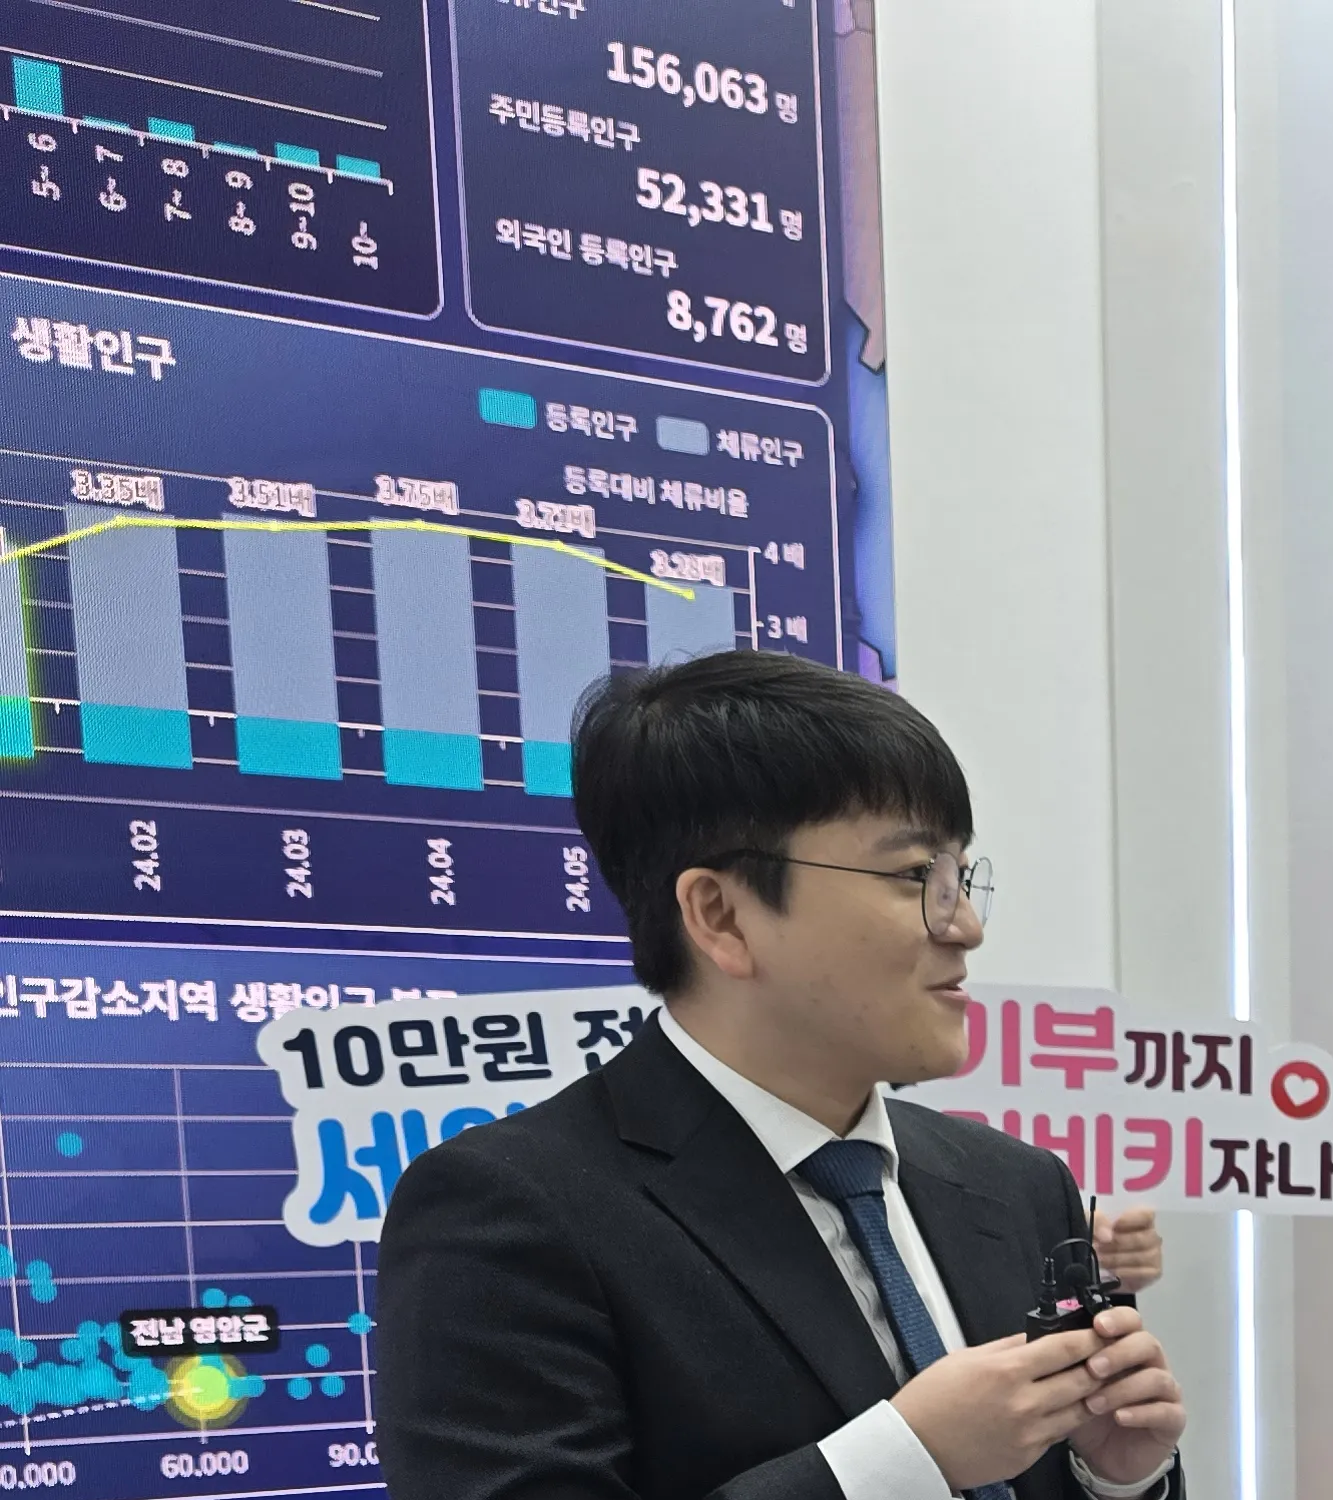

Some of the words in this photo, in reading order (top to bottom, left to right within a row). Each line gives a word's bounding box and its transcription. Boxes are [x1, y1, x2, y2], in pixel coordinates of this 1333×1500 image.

[607, 41, 769, 114] 156,063
[774, 92, 798, 124] 명
[489, 93, 641, 151] 주민등록인구
[636, 167, 774, 233] 52,331
[779, 209, 803, 241] 명
[495, 218, 572, 260] 외국인
[579, 233, 679, 278] 등록인구
[11, 316, 176, 381] 생활인구
[667, 290, 779, 347] 8,762
[784, 322, 808, 354] 명
[545, 401, 638, 442] 등록인구
[716, 429, 804, 467] 체류인구
[564, 465, 656, 504] 등록대비
[660, 479, 749, 519] 체류비율
[767, 615, 784, 639] 3
[129, 819, 161, 892] 24.02
[281, 828, 313, 899] 24.03
[426, 837, 456, 906] 24.04
[563, 845, 592, 913] 24.05
[283, 1011, 552, 1089] 10만원
[949, 999, 1253, 1095] 기부까지
[130, 1317, 186, 1347] 전남
[161, 1450, 250, 1479] 60.000
